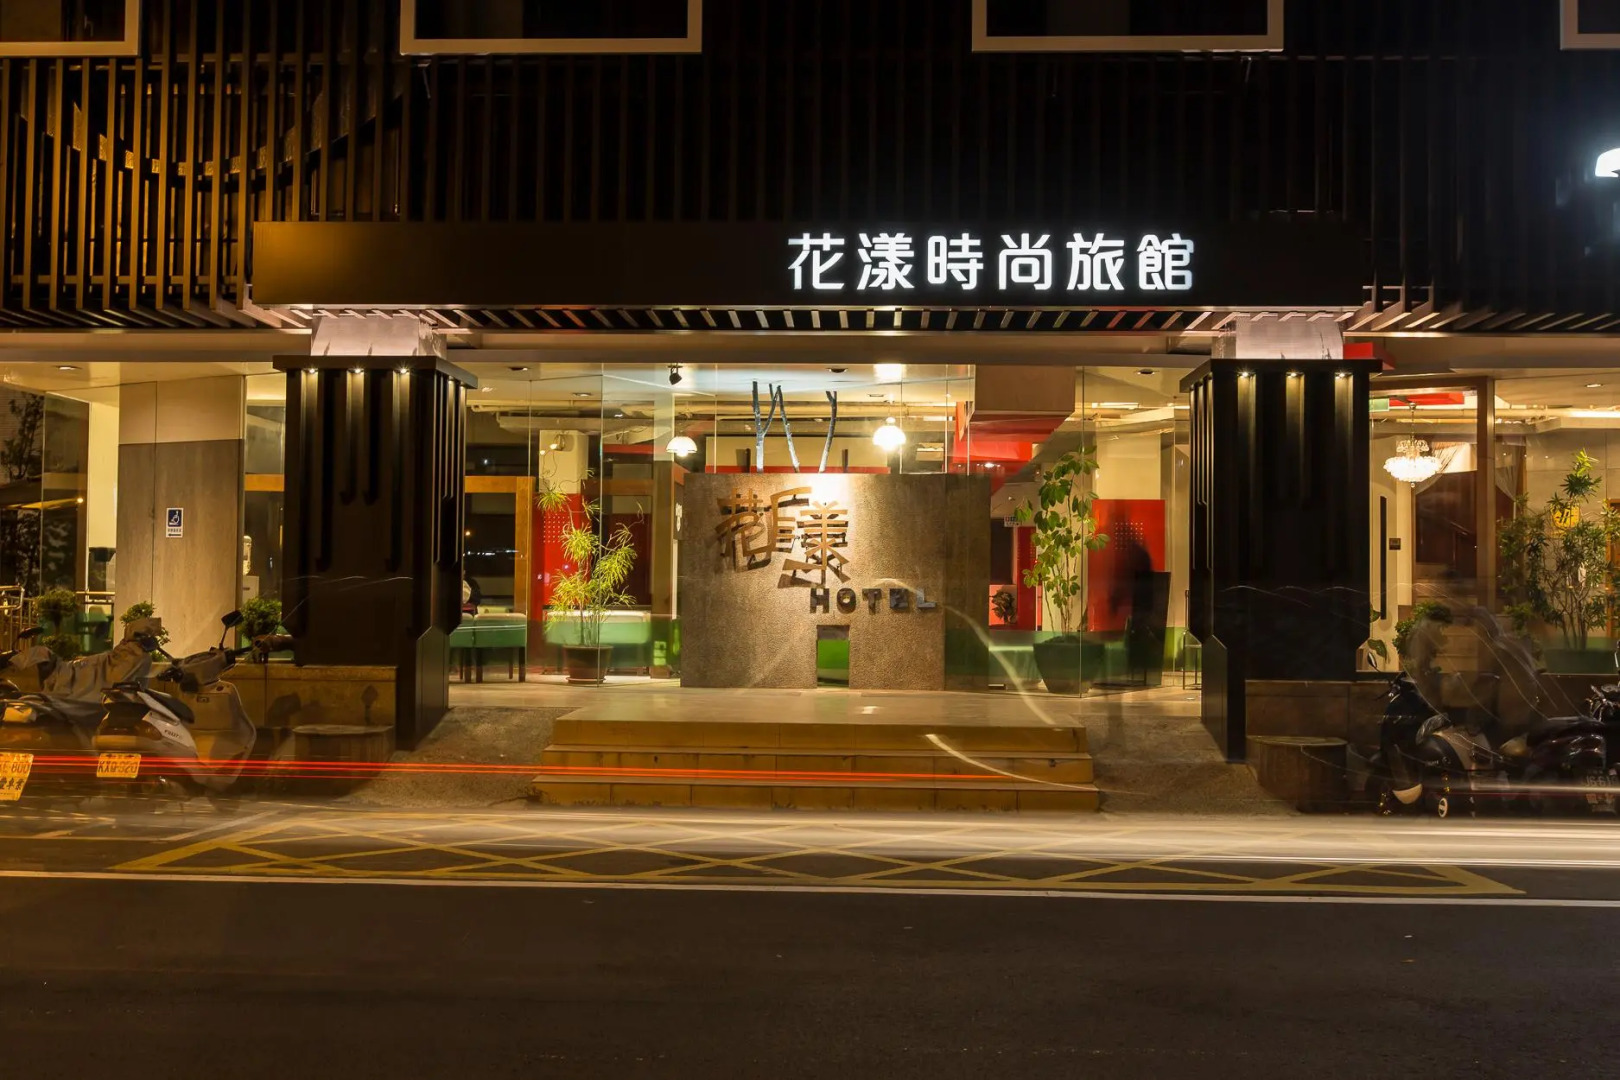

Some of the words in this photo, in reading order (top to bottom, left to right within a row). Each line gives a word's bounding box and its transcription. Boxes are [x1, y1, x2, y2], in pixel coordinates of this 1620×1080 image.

[787, 232, 1195, 291] 花漾時尚旅館
[809, 587, 937, 614] HOTEL
